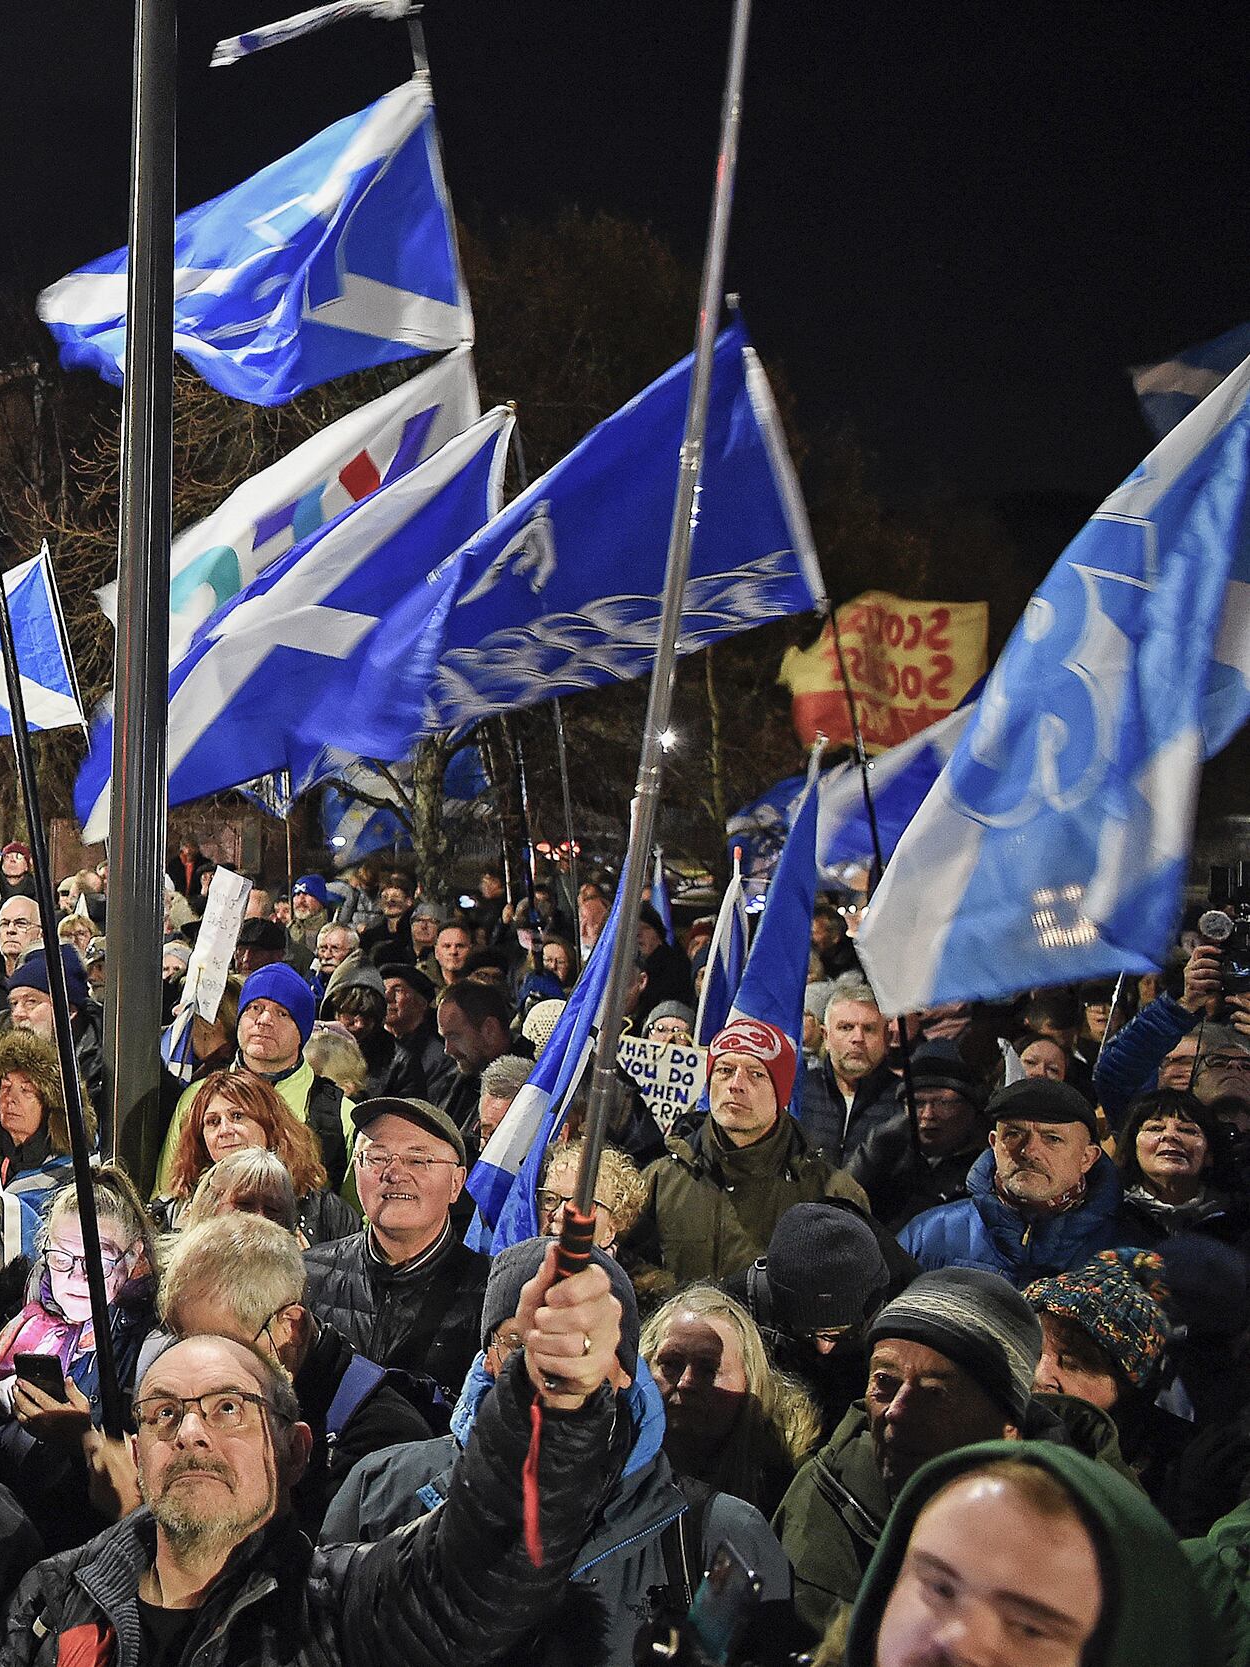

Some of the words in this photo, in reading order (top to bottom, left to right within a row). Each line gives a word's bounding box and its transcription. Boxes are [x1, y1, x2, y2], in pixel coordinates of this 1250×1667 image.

[670, 1049, 698, 1068] DO
[621, 1057, 658, 1080] YOU
[668, 1067, 695, 1086] DO
[641, 1083, 689, 1105] WHEN
